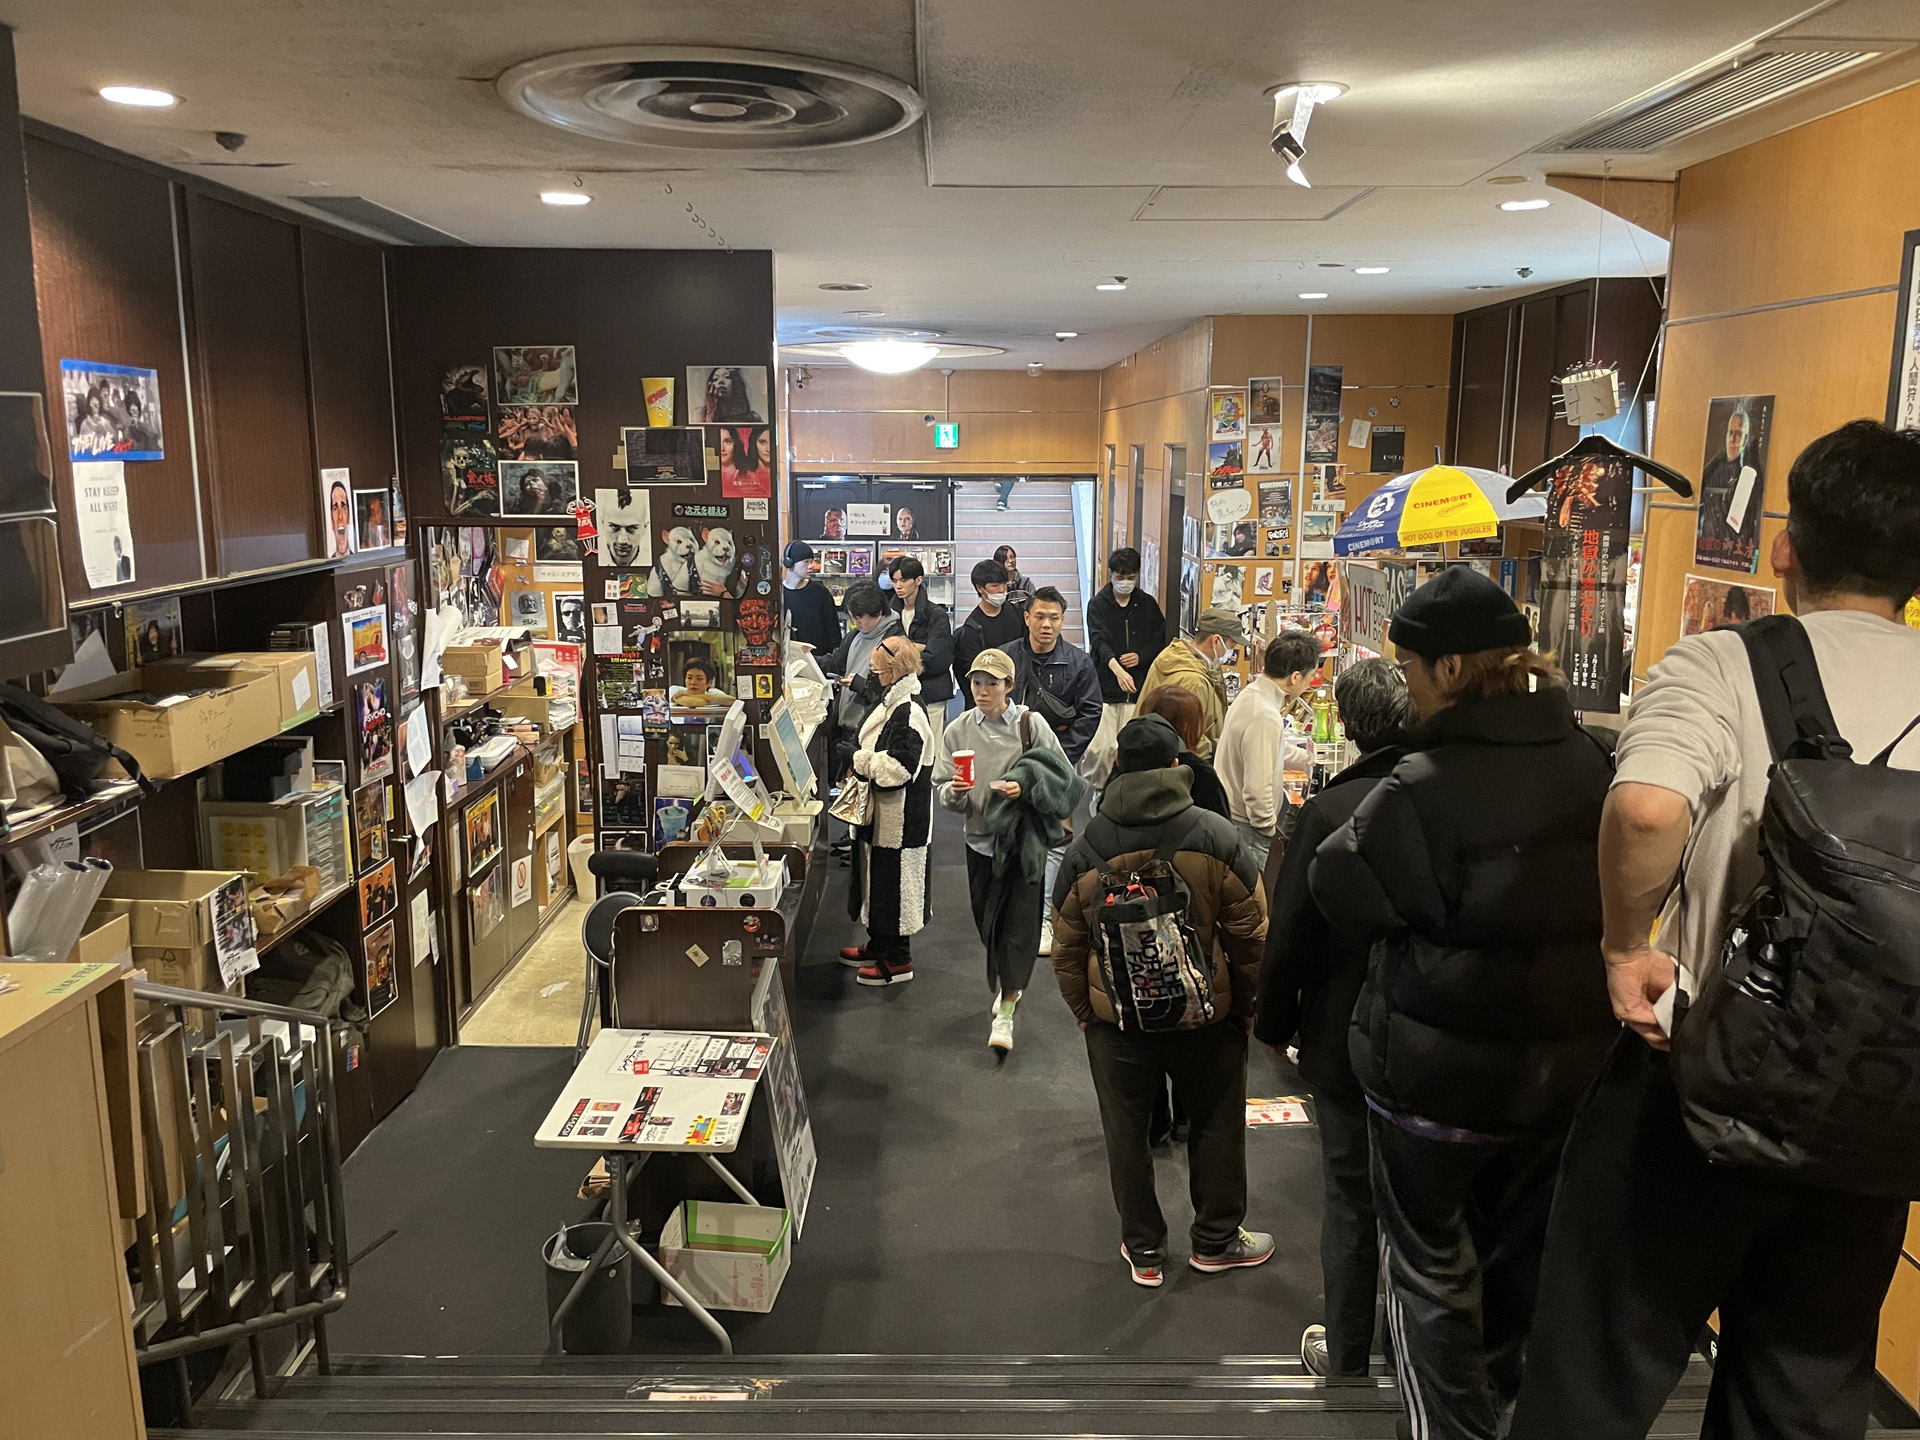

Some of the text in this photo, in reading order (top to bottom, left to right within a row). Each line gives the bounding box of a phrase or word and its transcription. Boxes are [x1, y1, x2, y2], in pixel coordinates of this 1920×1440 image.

[72, 432, 95, 456] THEY
[92, 432, 115, 456] LIVE
[85, 486, 119, 497] STAY ASLEEP
[90, 501, 118, 512] ALL NIGHT
[1413, 492, 1473, 509] CINEM@RT
[684, 505, 728, 517] 次元を超える
[1402, 524, 1493, 542] HOT DOG OF THE JUGGLER
[1347, 535, 1385, 552] CINEM@RT
[1353, 584, 1373, 639] HOT
[1127, 952, 1152, 998] FACE
[1163, 956, 1185, 998] THE
[45, 979, 81, 995] TAKE
